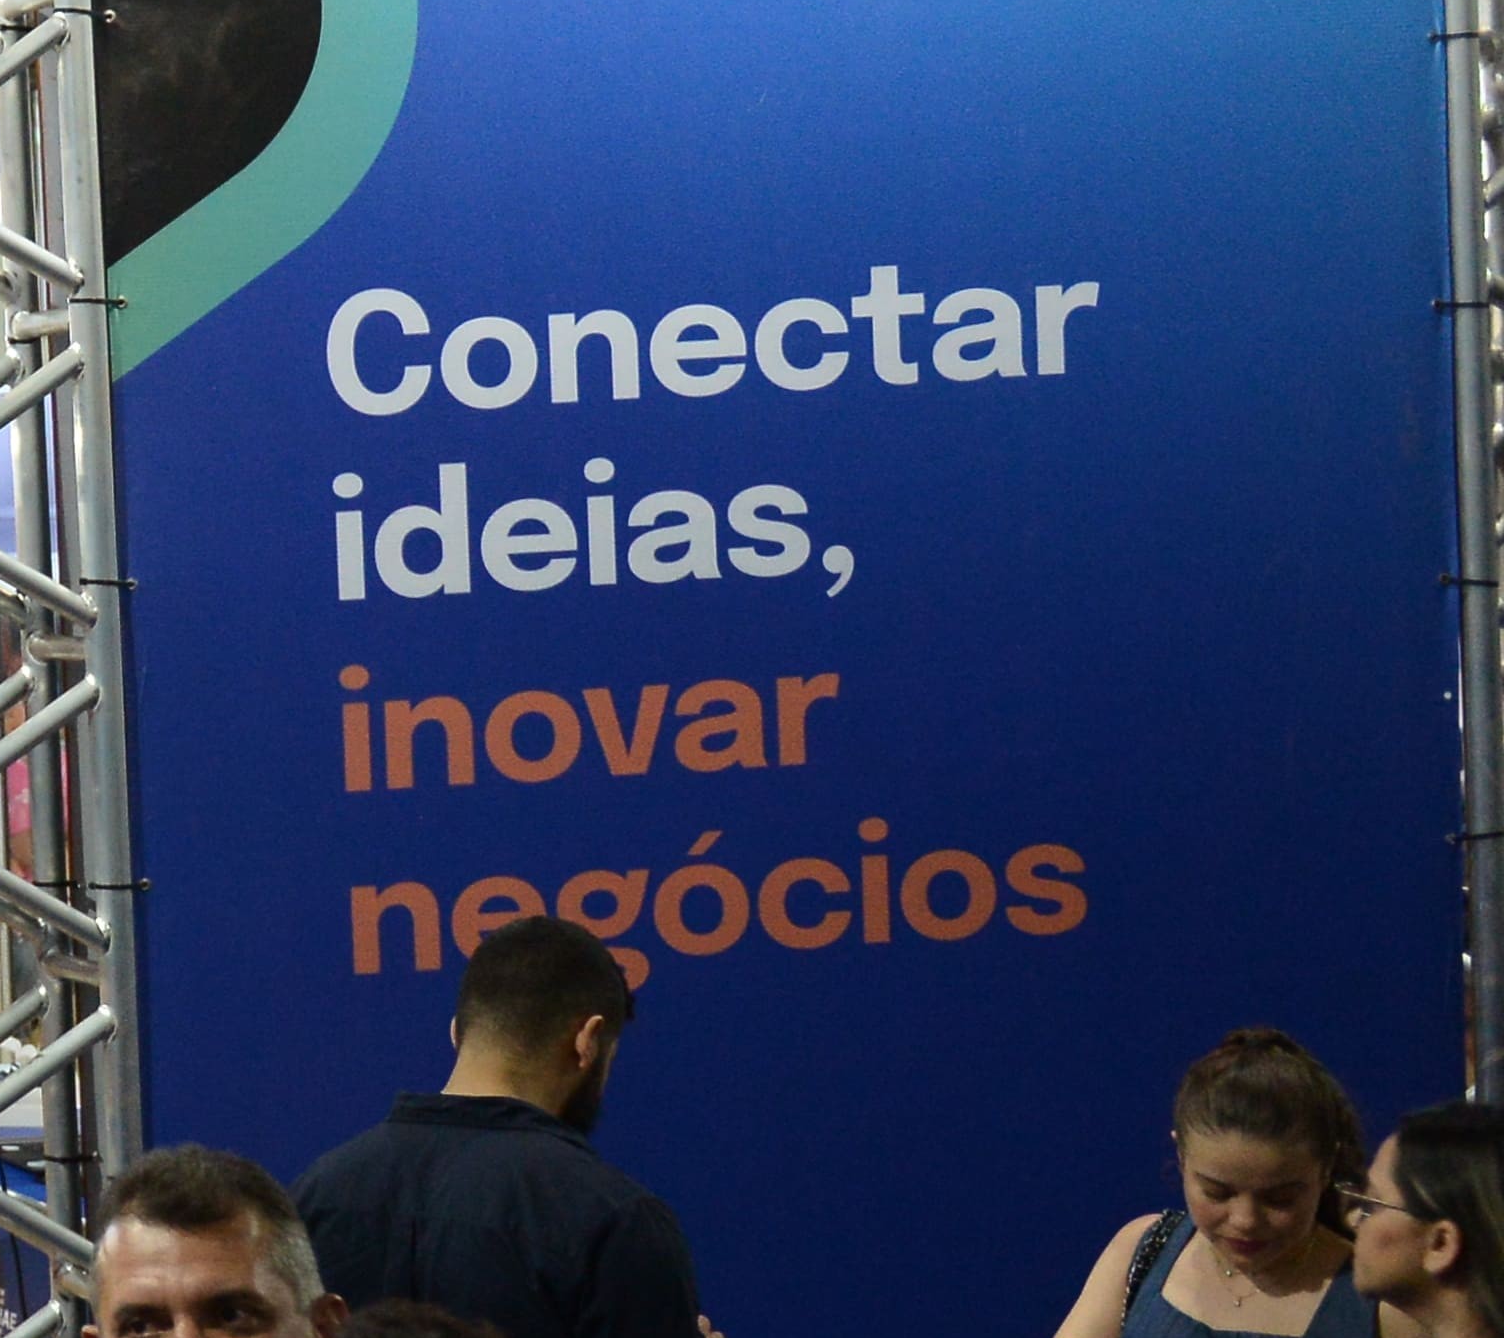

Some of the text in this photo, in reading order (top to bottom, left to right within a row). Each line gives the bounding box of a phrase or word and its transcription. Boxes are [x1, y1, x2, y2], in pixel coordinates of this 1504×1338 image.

[326, 264, 1101, 417] Conectar
[331, 457, 856, 602] ideias,
[337, 664, 840, 794] inovar
[349, 816, 1088, 993] negócios
